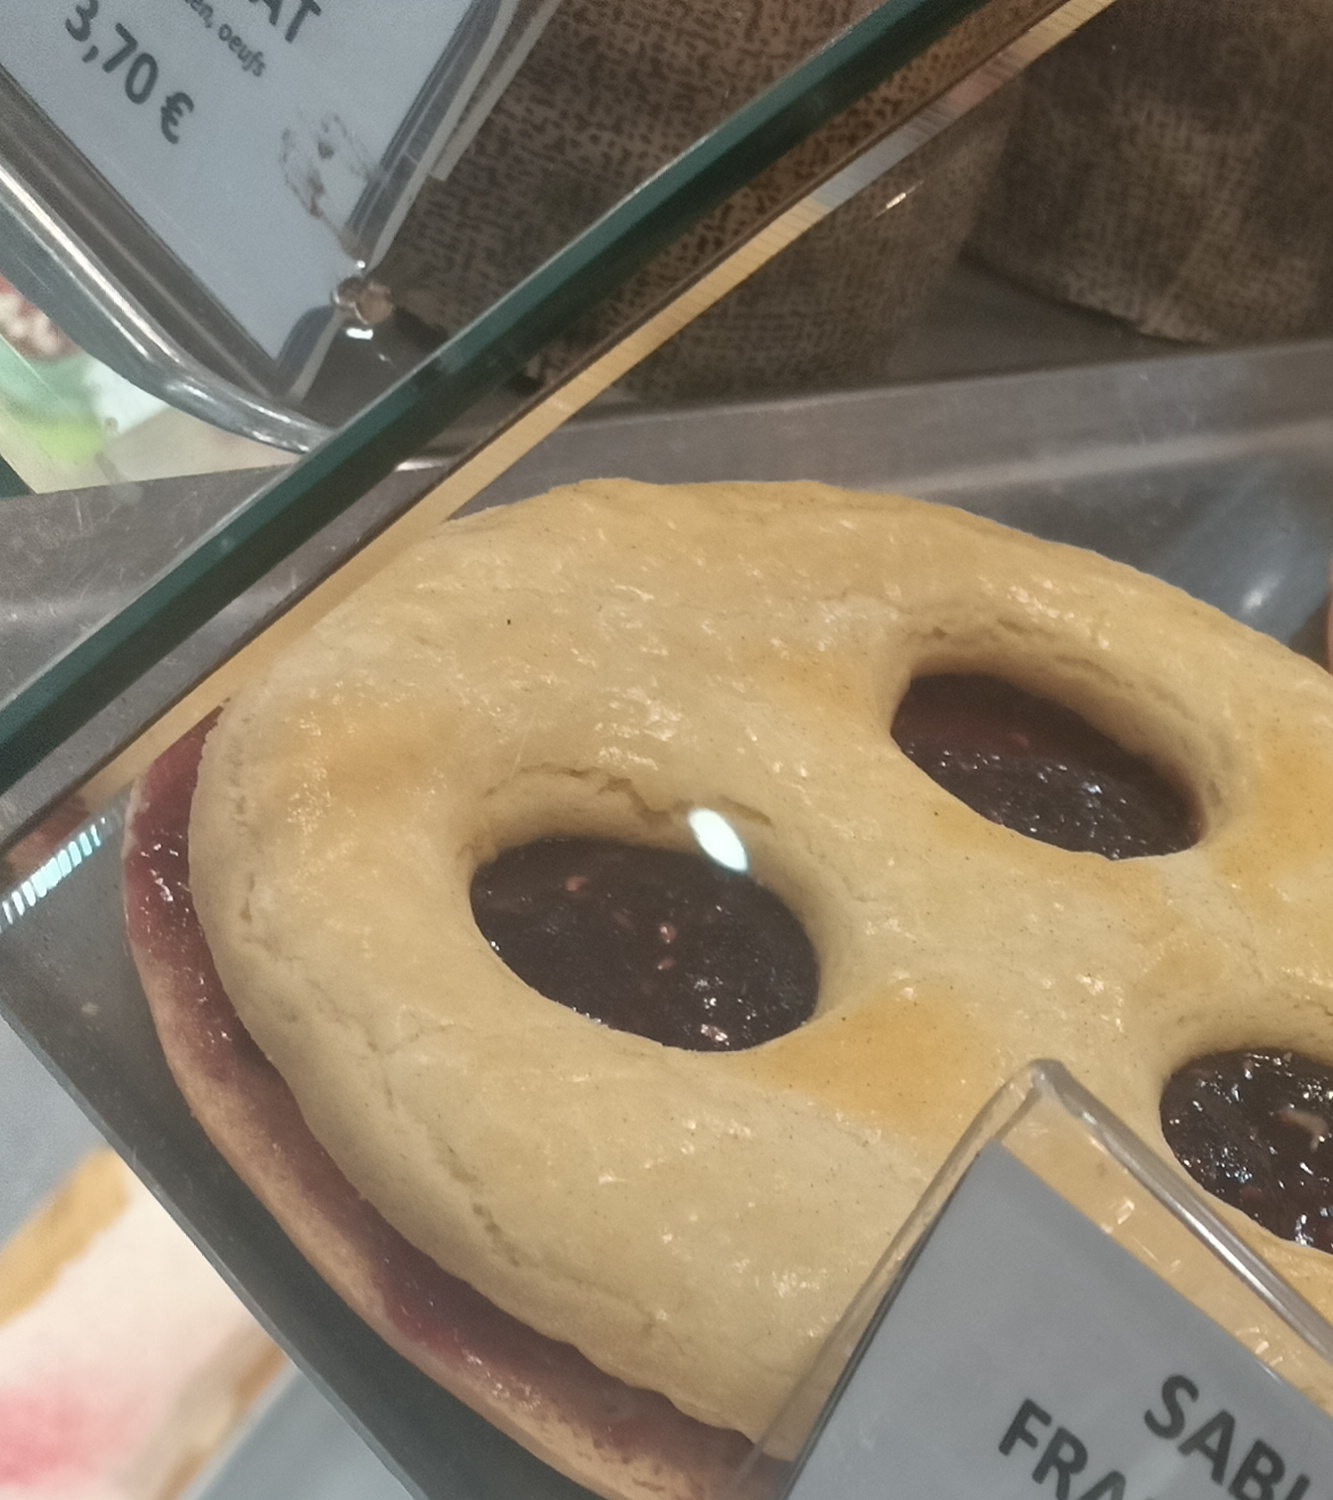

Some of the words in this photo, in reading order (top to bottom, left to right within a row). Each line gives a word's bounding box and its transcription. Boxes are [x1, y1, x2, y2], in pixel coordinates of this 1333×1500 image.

[65, 0, 159, 105] 3,70
[159, 91, 195, 144] €
[217, 23, 266, 77] oeufs
